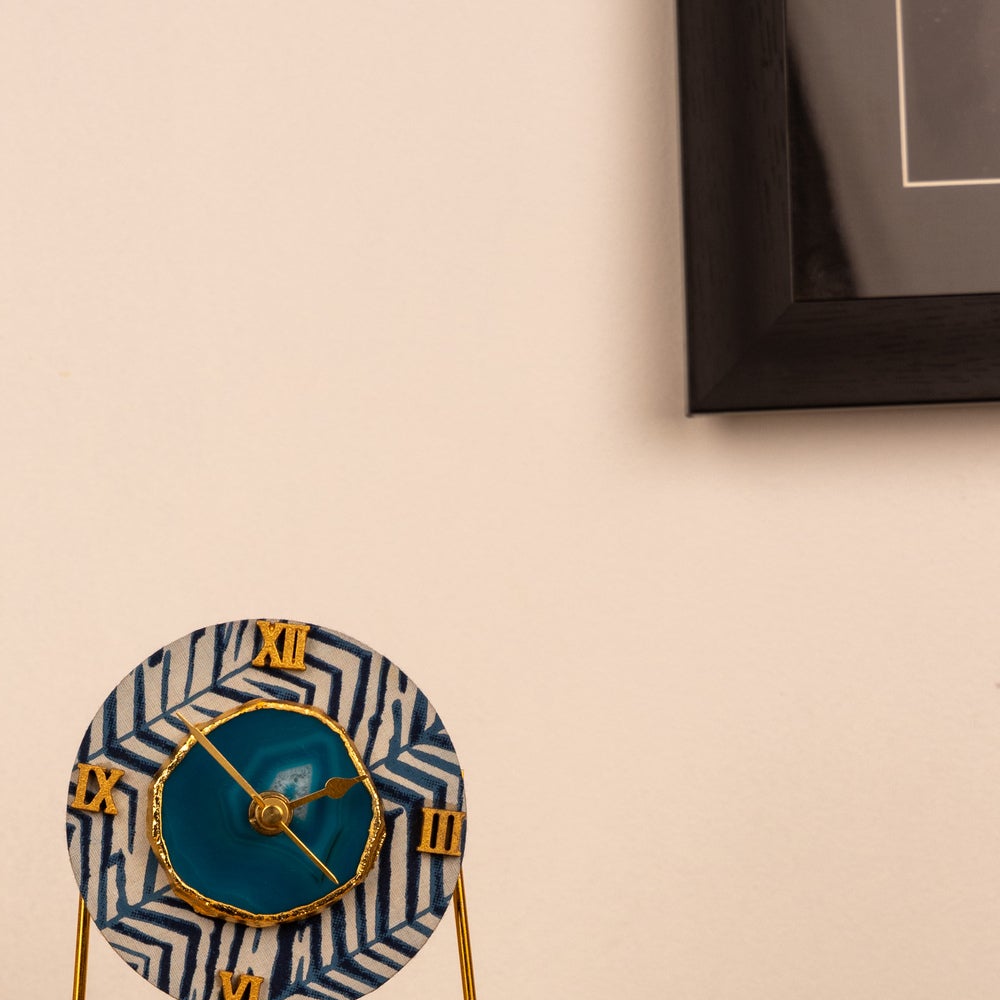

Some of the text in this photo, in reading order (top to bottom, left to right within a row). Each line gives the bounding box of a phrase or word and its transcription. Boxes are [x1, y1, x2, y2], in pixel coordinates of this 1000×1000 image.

[252, 619, 310, 671] XII
[71, 763, 125, 814] IX
[416, 806, 465, 857] III
